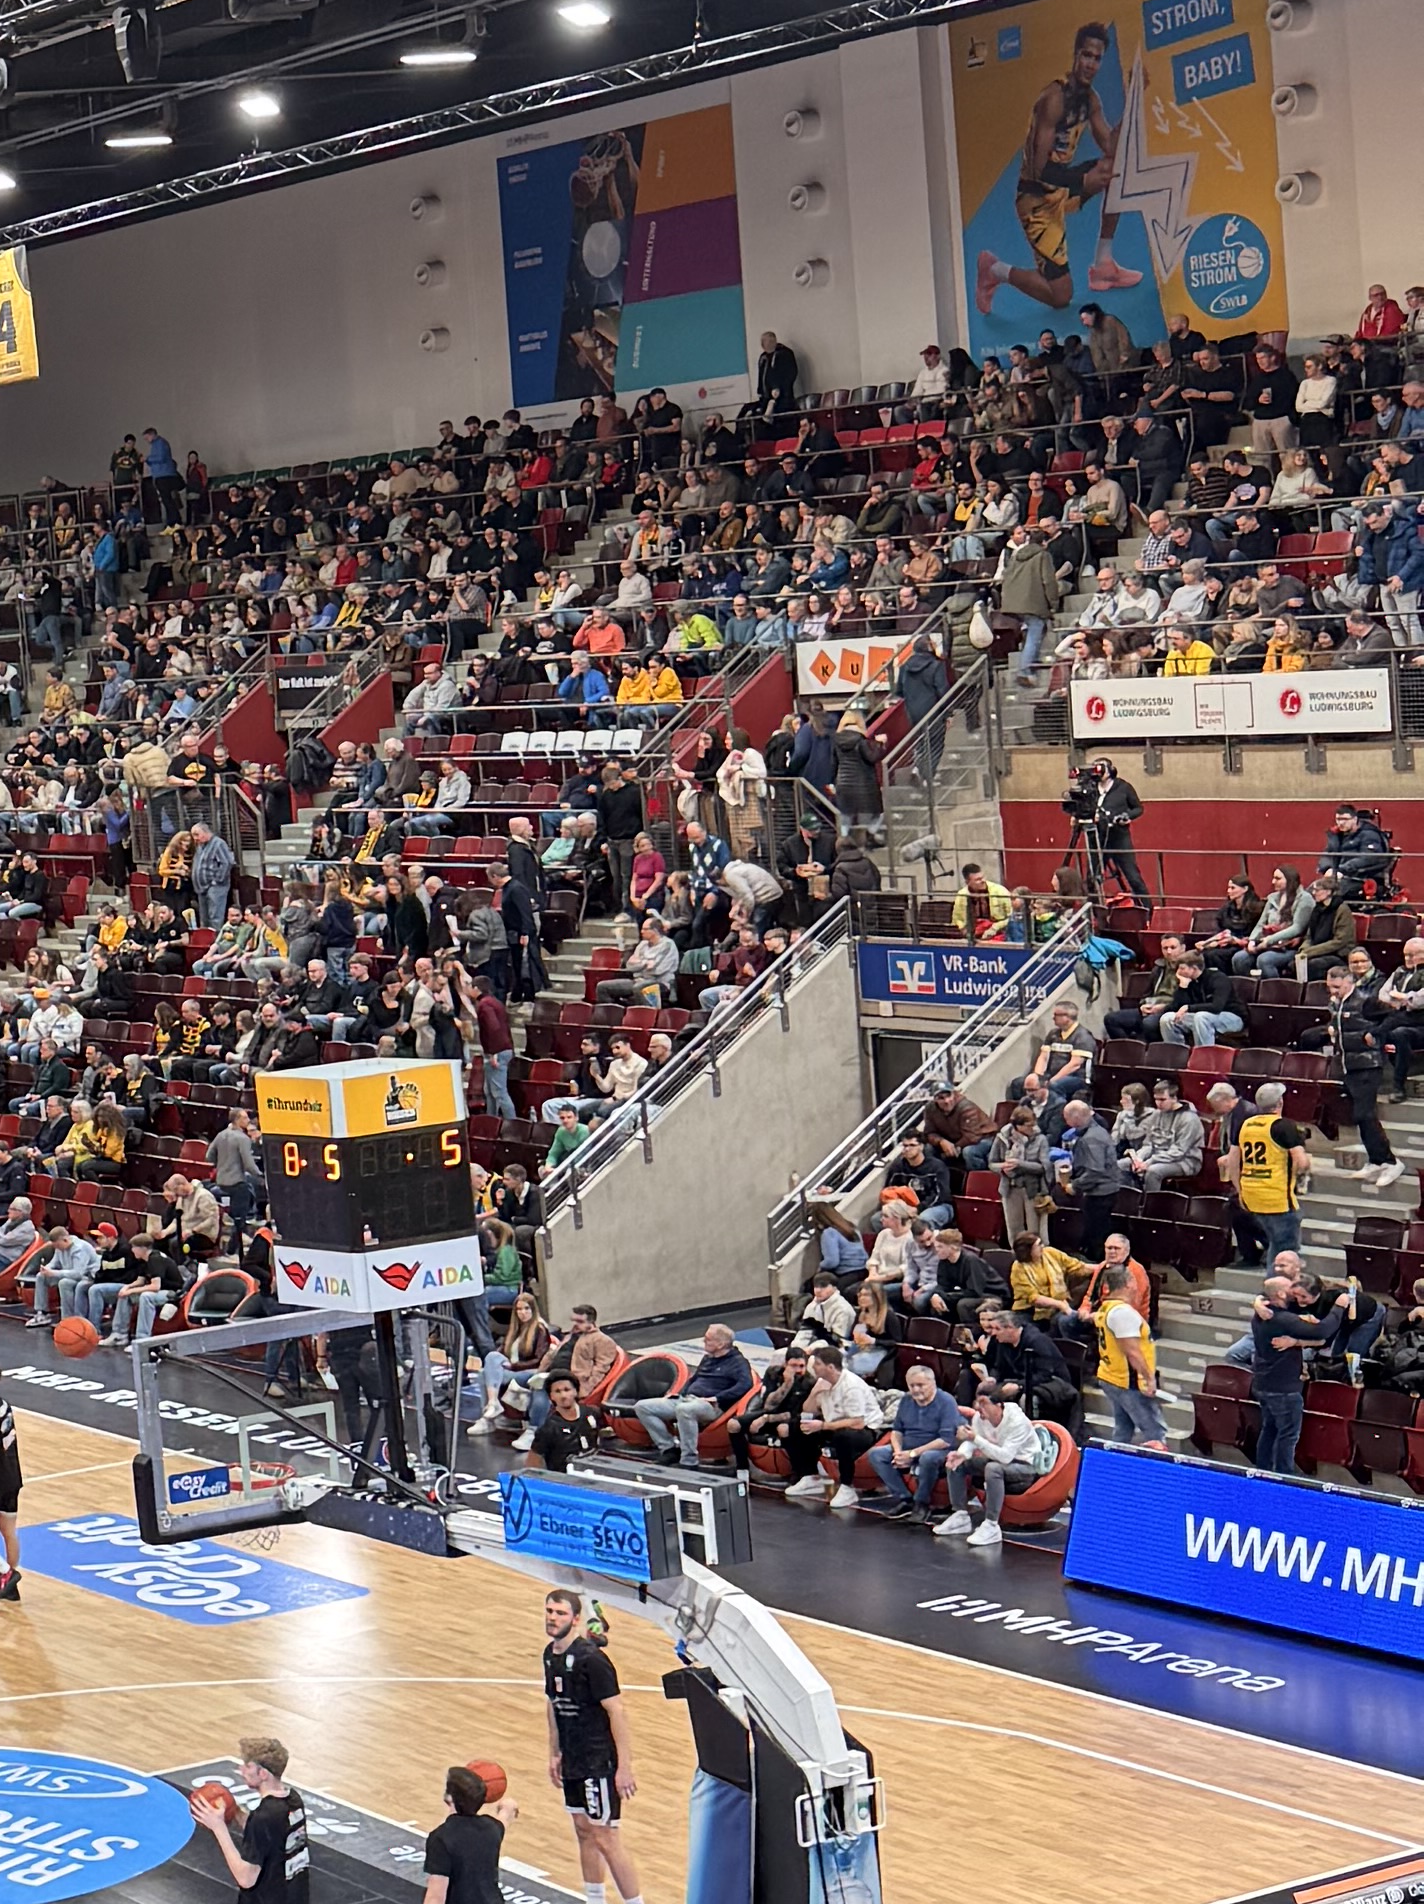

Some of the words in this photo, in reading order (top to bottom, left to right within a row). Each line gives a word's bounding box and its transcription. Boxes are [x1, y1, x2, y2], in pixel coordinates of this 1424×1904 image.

[1184, 50, 1242, 89] BABY!
[1189, 249, 1236, 272] RIESEN
[1190, 264, 1238, 287] STROM
[941, 954, 1008, 975] VR-Bank
[283, 1141, 300, 1177] 8
[323, 1143, 342, 1181] 5
[441, 1128, 462, 1167] 5
[1242, 1141, 1267, 1166] 22
[314, 1275, 352, 1297] AIDA
[421, 1263, 474, 1290] AIDA
[1, 1364, 105, 1393] MHP
[189, 1480, 228, 1499] Credit
[592, 1524, 645, 1556] SEVO
[985, 1607, 1286, 1694] MHPArena
